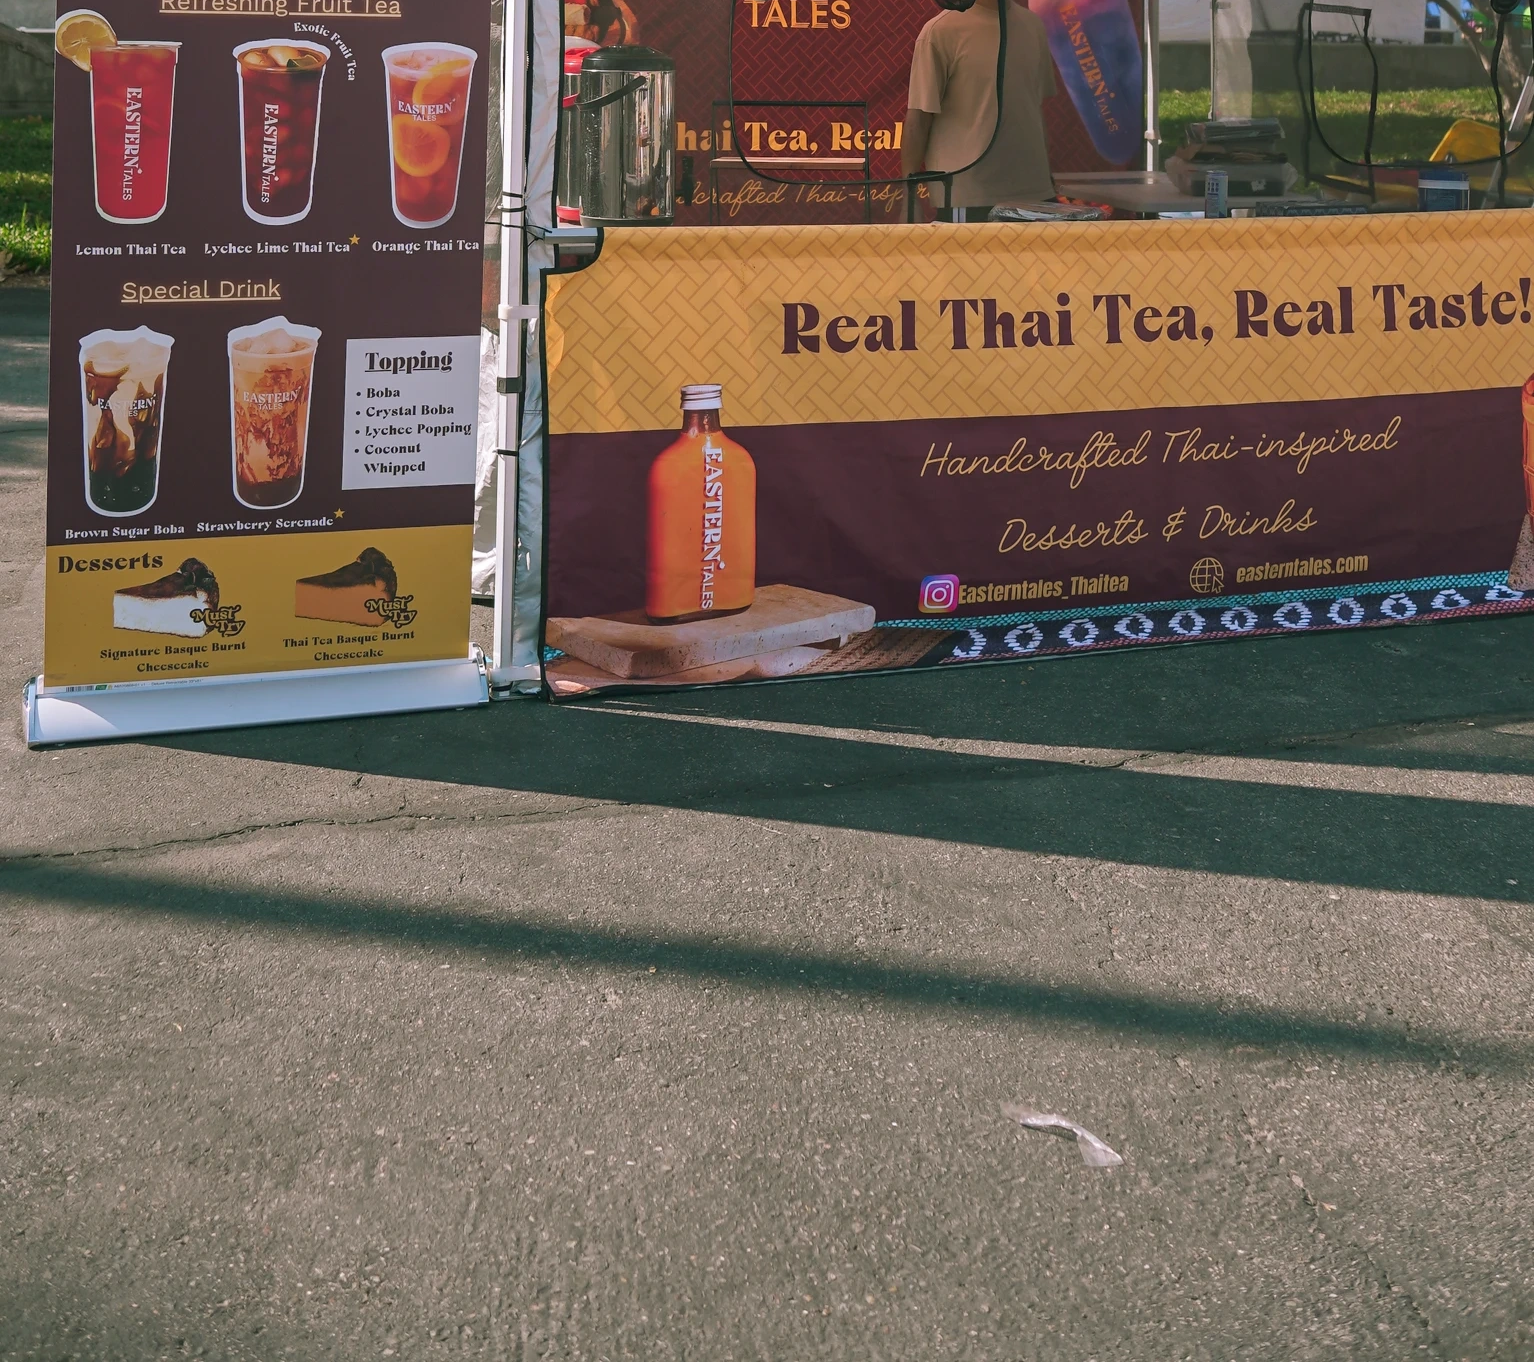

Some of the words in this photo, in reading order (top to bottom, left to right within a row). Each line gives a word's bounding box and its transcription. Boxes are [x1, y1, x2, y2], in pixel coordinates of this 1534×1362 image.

[294, 22, 330, 37] Exotic
[330, 32, 353, 59] Fruit
[346, 59, 357, 81] Tea
[1058, 1, 1109, 98] EASTERN
[398, 100, 452, 115] EASTERN
[124, 87, 143, 169] EASTERN
[411, 114, 437, 122] TALES
[262, 103, 279, 176] EASTERN
[676, 120, 732, 151] hai
[744, 122, 819, 155] Tea,
[831, 121, 903, 151] Real
[122, 168, 134, 201] TALES
[261, 175, 271, 203] TALES
[75, 244, 122, 256] Lemon
[126, 243, 157, 256] Thai
[161, 243, 187, 255] Tea
[204, 242, 253, 257] Lychee
[256, 241, 289, 254] Lime
[292, 241, 323, 253] Thai
[325, 241, 350, 253] Tea
[372, 240, 421, 254] Orange
[424, 239, 454, 251] Thai
[457, 239, 480, 251] Tea
[122, 280, 210, 305] Special
[220, 278, 281, 299] Drink
[781, 300, 919, 355] Real
[939, 291, 1075, 350] Thai
[1092, 294, 1215, 347] Tea,
[1233, 286, 1355, 339] Real
[1372, 277, 1533, 332] Taste!
[365, 350, 453, 375] Topping
[243, 389, 299, 405] EASTERN
[366, 387, 401, 399] Boba
[97, 397, 153, 410] EAERN
[365, 405, 417, 419] Crystal
[421, 404, 454, 416] Boba
[365, 424, 413, 439] Lychee
[417, 421, 472, 437] Popping
[364, 442, 421, 455] Coconut
[920, 429, 1153, 489] Handcrafted
[1161, 415, 1402, 475] Thai-inspired
[363, 461, 426, 476] Whipped
[703, 447, 723, 563] EASTERN
[65, 528, 109, 539] Brown
[112, 526, 150, 539] Sugar
[153, 524, 185, 535] Boba
[196, 520, 272, 533] Strawberry
[275, 516, 334, 528] Serenade
[998, 508, 1149, 554] Desserts
[1161, 505, 1187, 542] &
[1198, 498, 1318, 541] Drinks
[58, 552, 164, 574] Desserts
[1236, 555, 1369, 584] easterntales.com
[701, 562, 715, 610] TALES
[958, 573, 1129, 605] Easterntales_Thaitea
[190, 605, 241, 626] Must
[364, 595, 414, 617] Must
[216, 620, 246, 637] Try
[389, 610, 417, 628] Try
[283, 637, 309, 648] Thai
[311, 636, 333, 646] Tea
[336, 634, 378, 646] Basque
[381, 630, 415, 641] Burnt
[100, 648, 161, 660] Signature
[164, 643, 208, 656] Basque
[212, 640, 246, 652] Burnt
[314, 648, 384, 661] Cheesecake
[137, 659, 210, 672] Cheesecake
